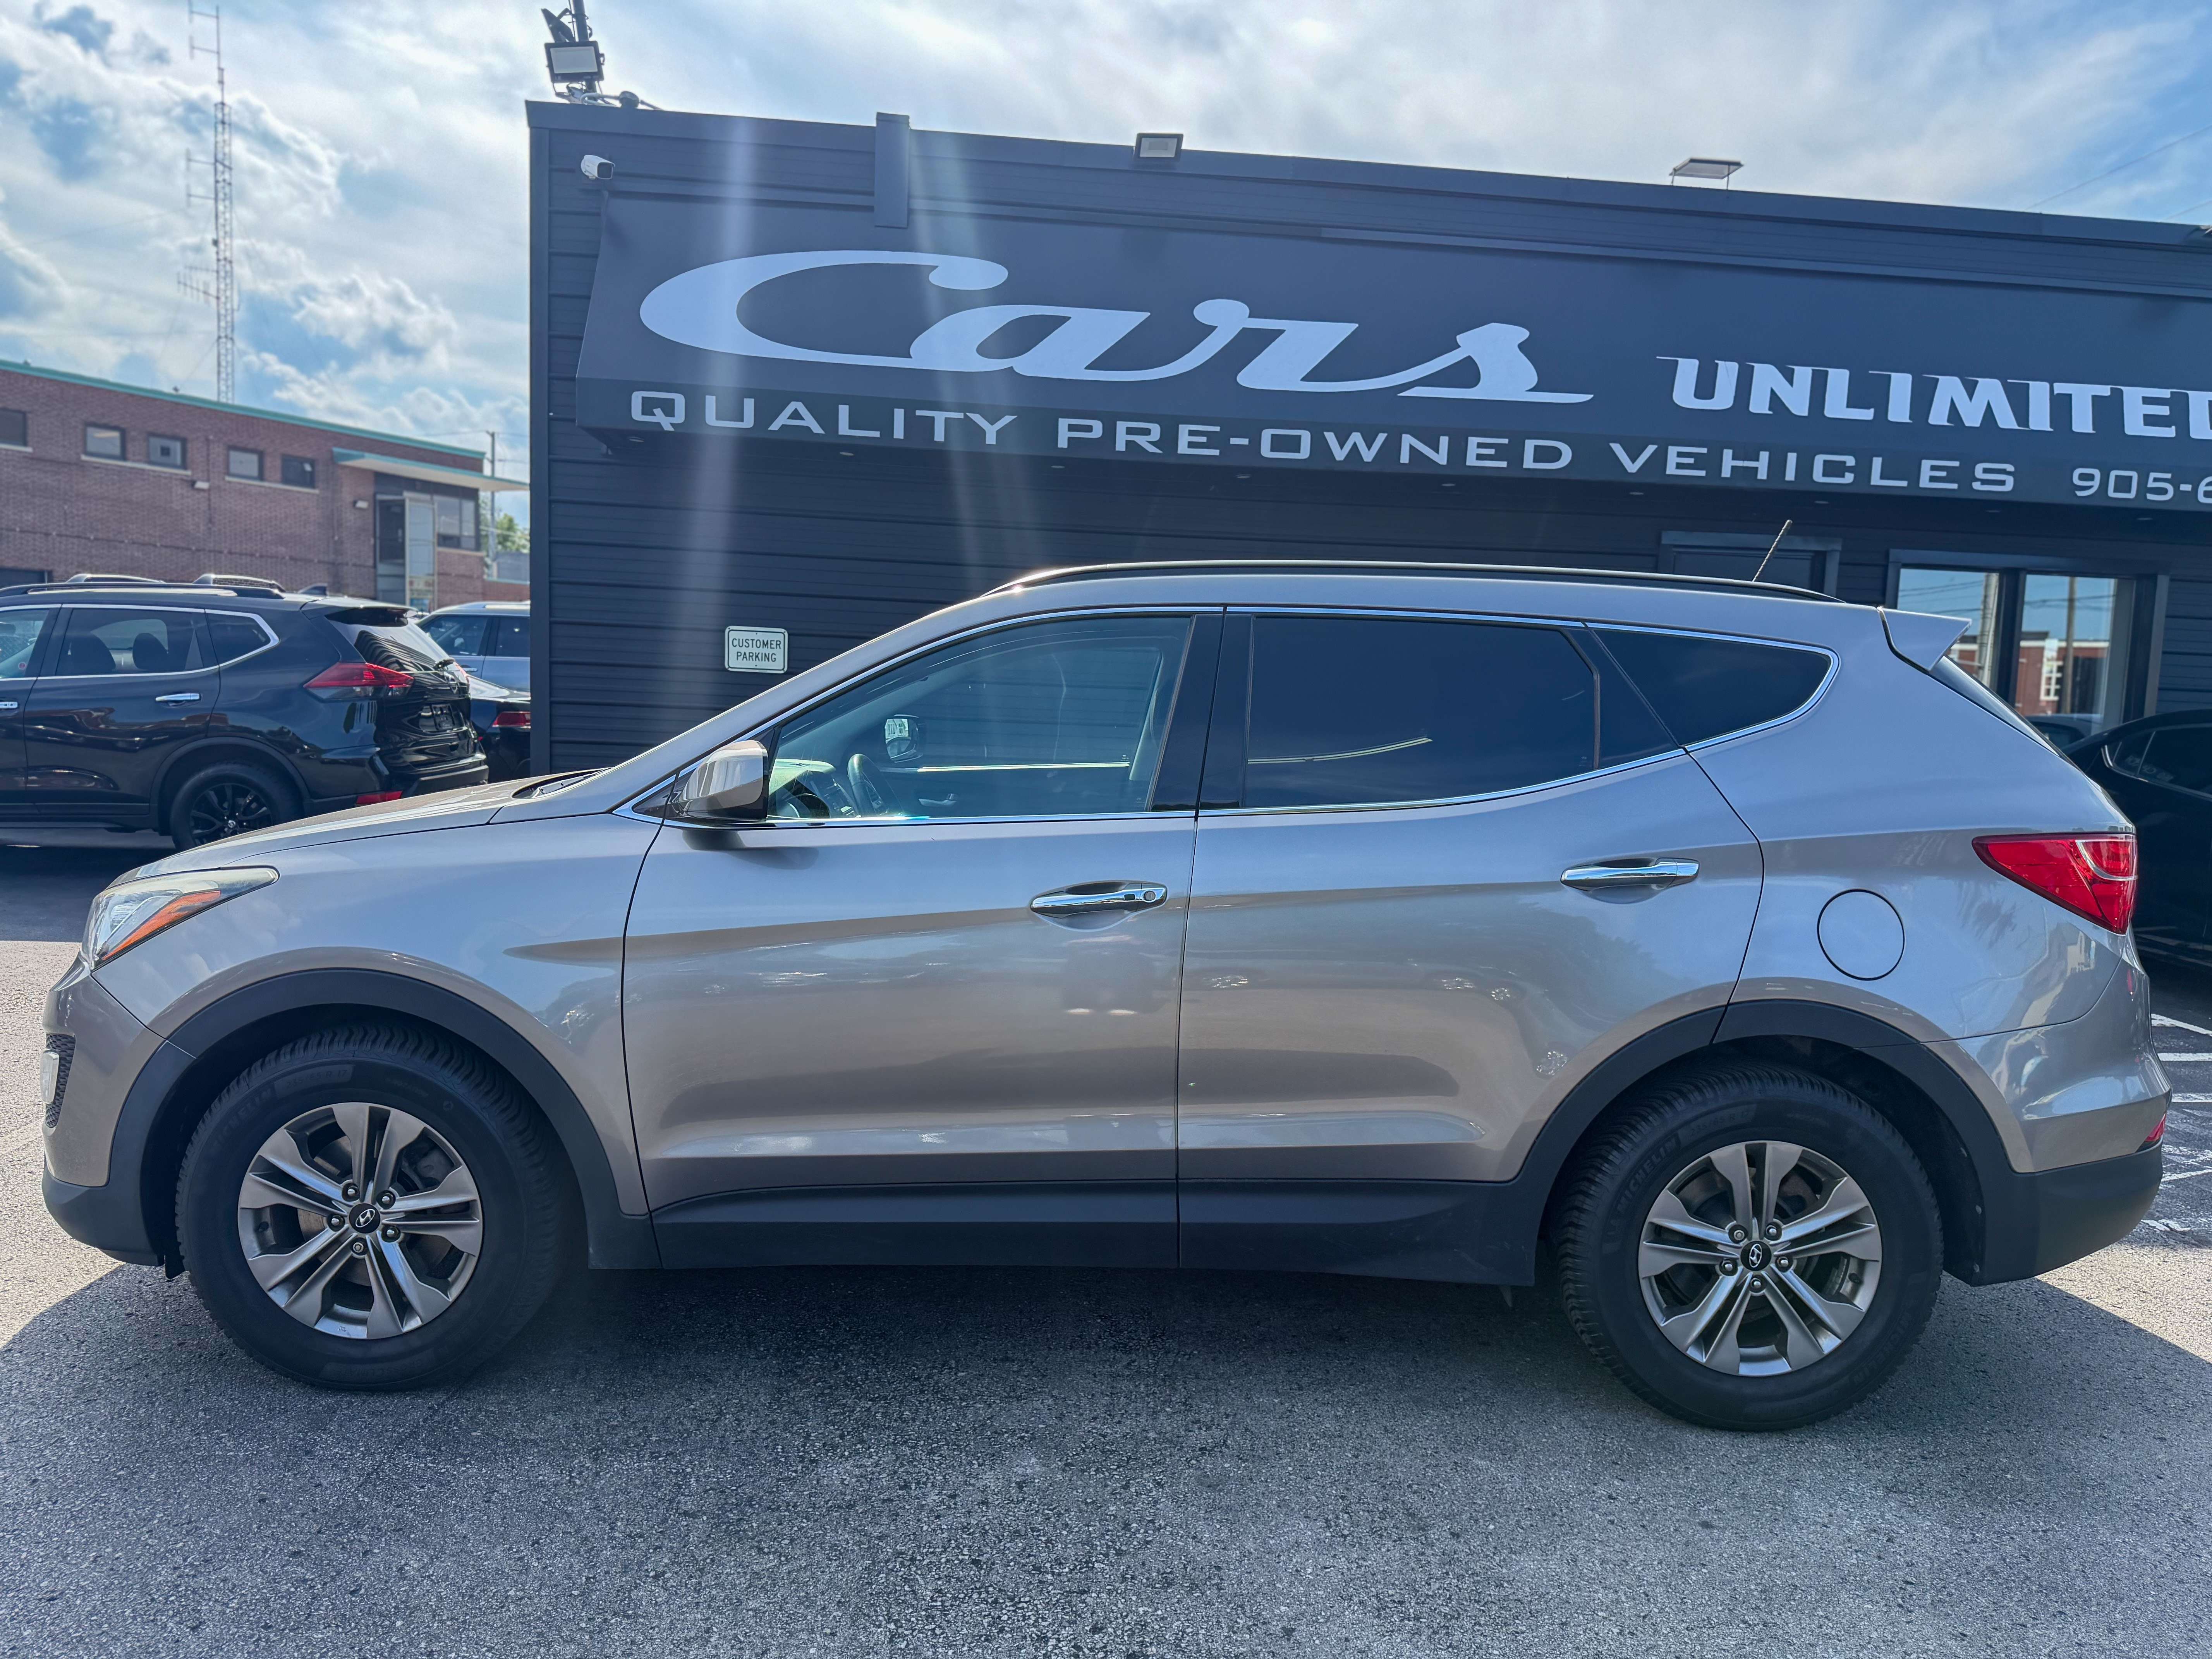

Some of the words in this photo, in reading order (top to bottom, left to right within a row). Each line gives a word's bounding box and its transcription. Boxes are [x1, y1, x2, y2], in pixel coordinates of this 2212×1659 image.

[640, 250, 1594, 403] Cars
[632, 391, 1017, 445] QUALITY
[1058, 418, 1572, 469] PRE-OWNED
[1609, 443, 2015, 492] VEHICLES
[732, 638, 781, 649] CUSTOMER
[736, 651, 776, 662] PARKING
[337, 1069, 348, 1078] 17
[1616, 1136, 1679, 1212] MICHELIN
